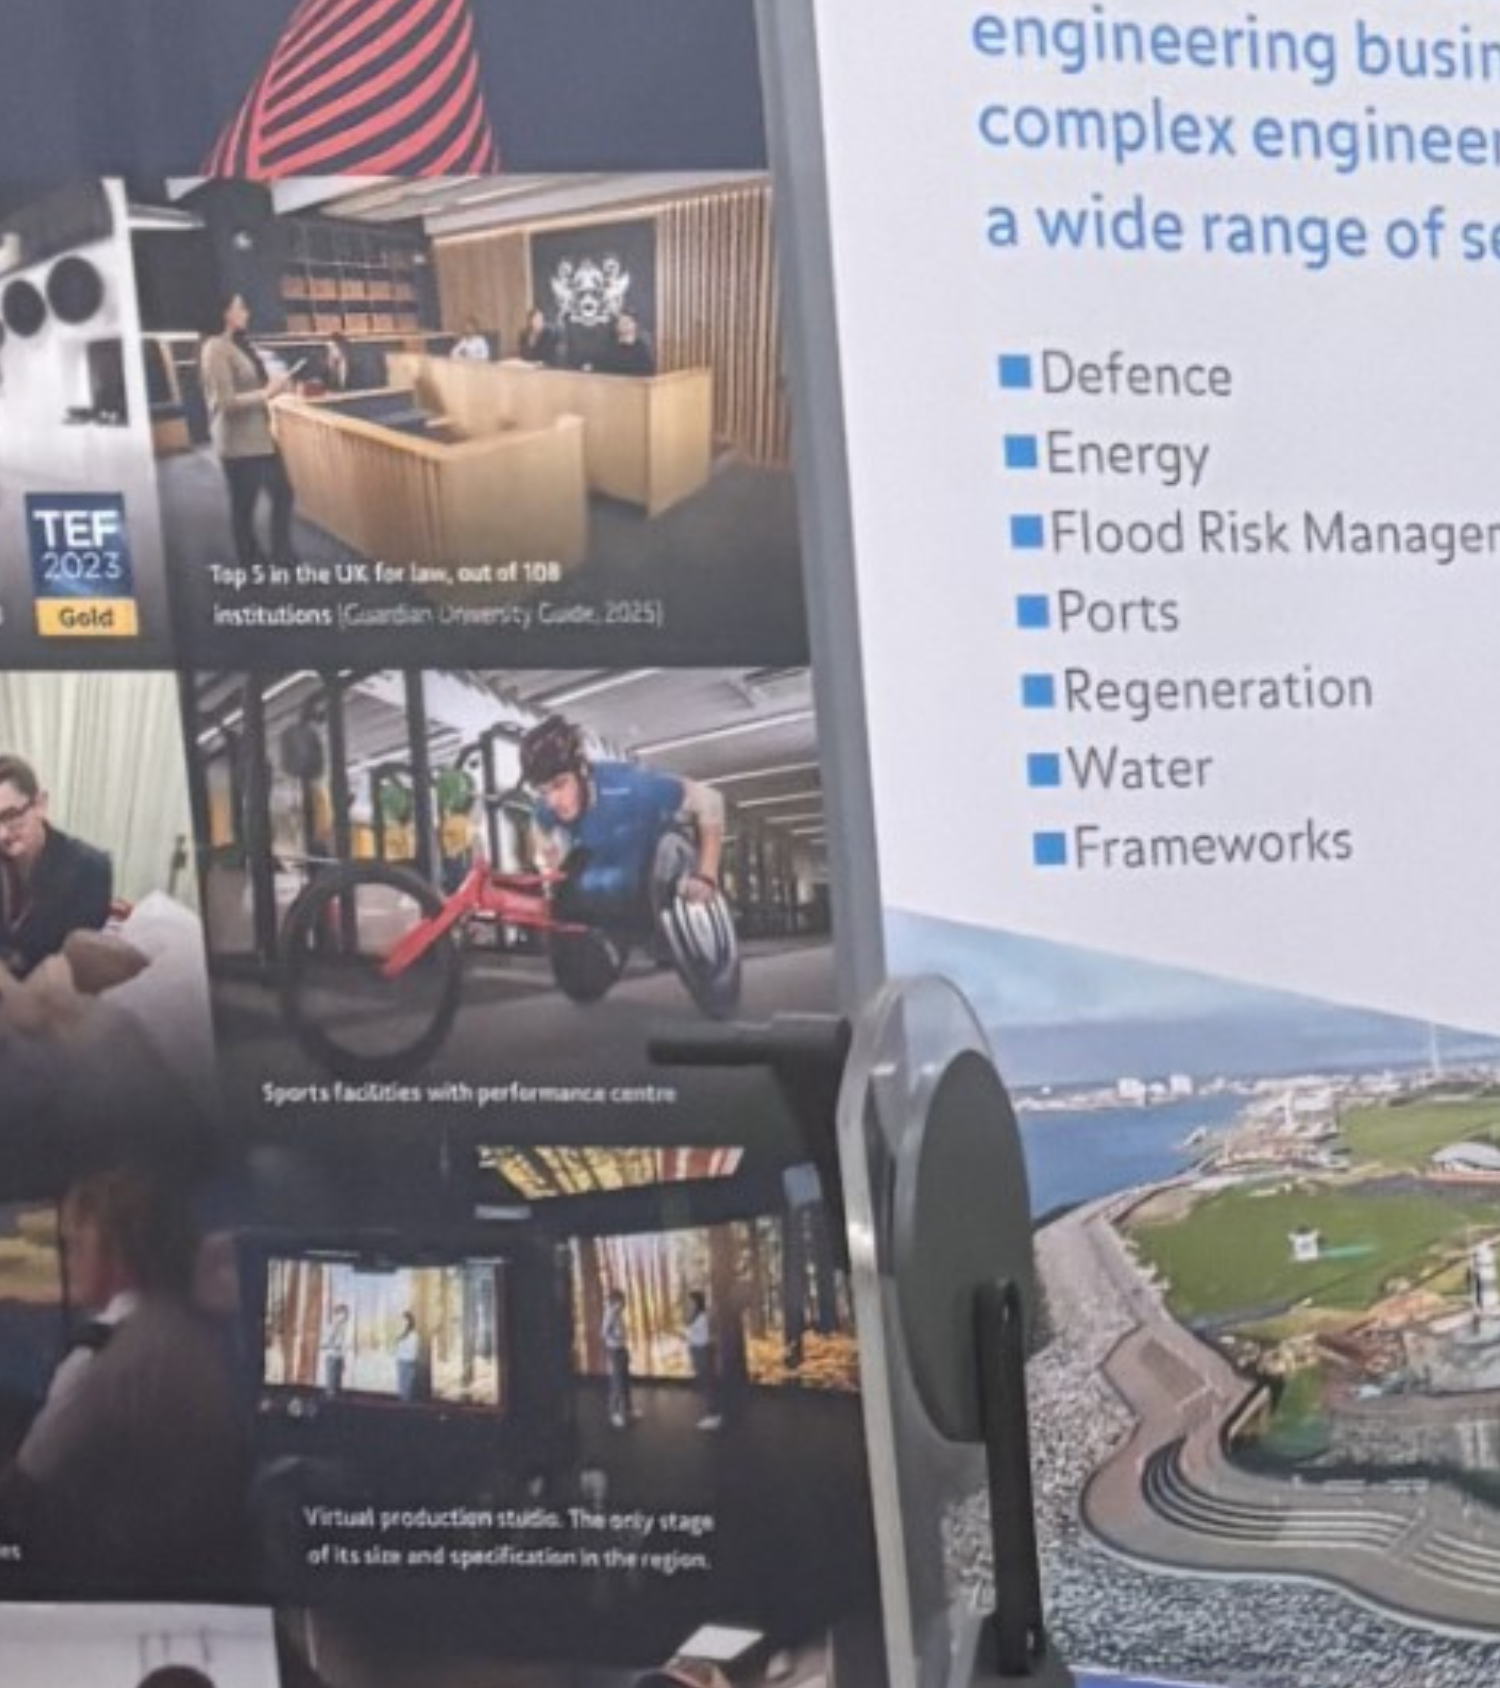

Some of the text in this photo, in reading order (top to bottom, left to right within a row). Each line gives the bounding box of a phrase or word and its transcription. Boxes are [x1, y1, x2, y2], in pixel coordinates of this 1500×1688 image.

[972, 4, 1336, 86] engineering
[978, 97, 1236, 165] complex
[986, 205, 1019, 247] a
[1035, 192, 1184, 252] wide
[1202, 212, 1368, 270] range
[1386, 205, 1446, 260] of
[1040, 349, 1234, 398] Defence
[1046, 431, 1210, 486] Energy
[32, 509, 120, 547] TEF
[1050, 508, 1186, 557] Flood
[1198, 508, 1292, 556] Risk
[43, 551, 123, 580] 2023
[210, 563, 248, 591] Top
[252, 563, 266, 585] 5
[270, 563, 290, 585] in
[296, 562, 331, 585] the
[335, 563, 369, 585] UK
[375, 561, 405, 583] for
[411, 561, 454, 585] law,
[457, 564, 493, 583] out
[496, 561, 518, 583] of
[58, 605, 116, 628] Gold
[213, 602, 334, 627] institutions
[1057, 590, 1180, 637] Ports
[1064, 665, 1374, 721] Regeneration
[1068, 745, 1214, 792] Water
[1074, 819, 1354, 870] Frameworks
[262, 1081, 678, 1108] Sports facilities with performance centre
[303, 1505, 374, 1528] Virtual
[379, 1506, 494, 1533] production
[567, 1507, 606, 1530] The
[608, 1509, 656, 1536] only
[659, 1511, 716, 1537] stage
[308, 1543, 331, 1565] of
[334, 1544, 362, 1565] its
[364, 1544, 403, 1566] size
[407, 1545, 445, 1566] and
[448, 1544, 577, 1571] specification
[579, 1546, 600, 1568] in
[603, 1546, 637, 1569] the
